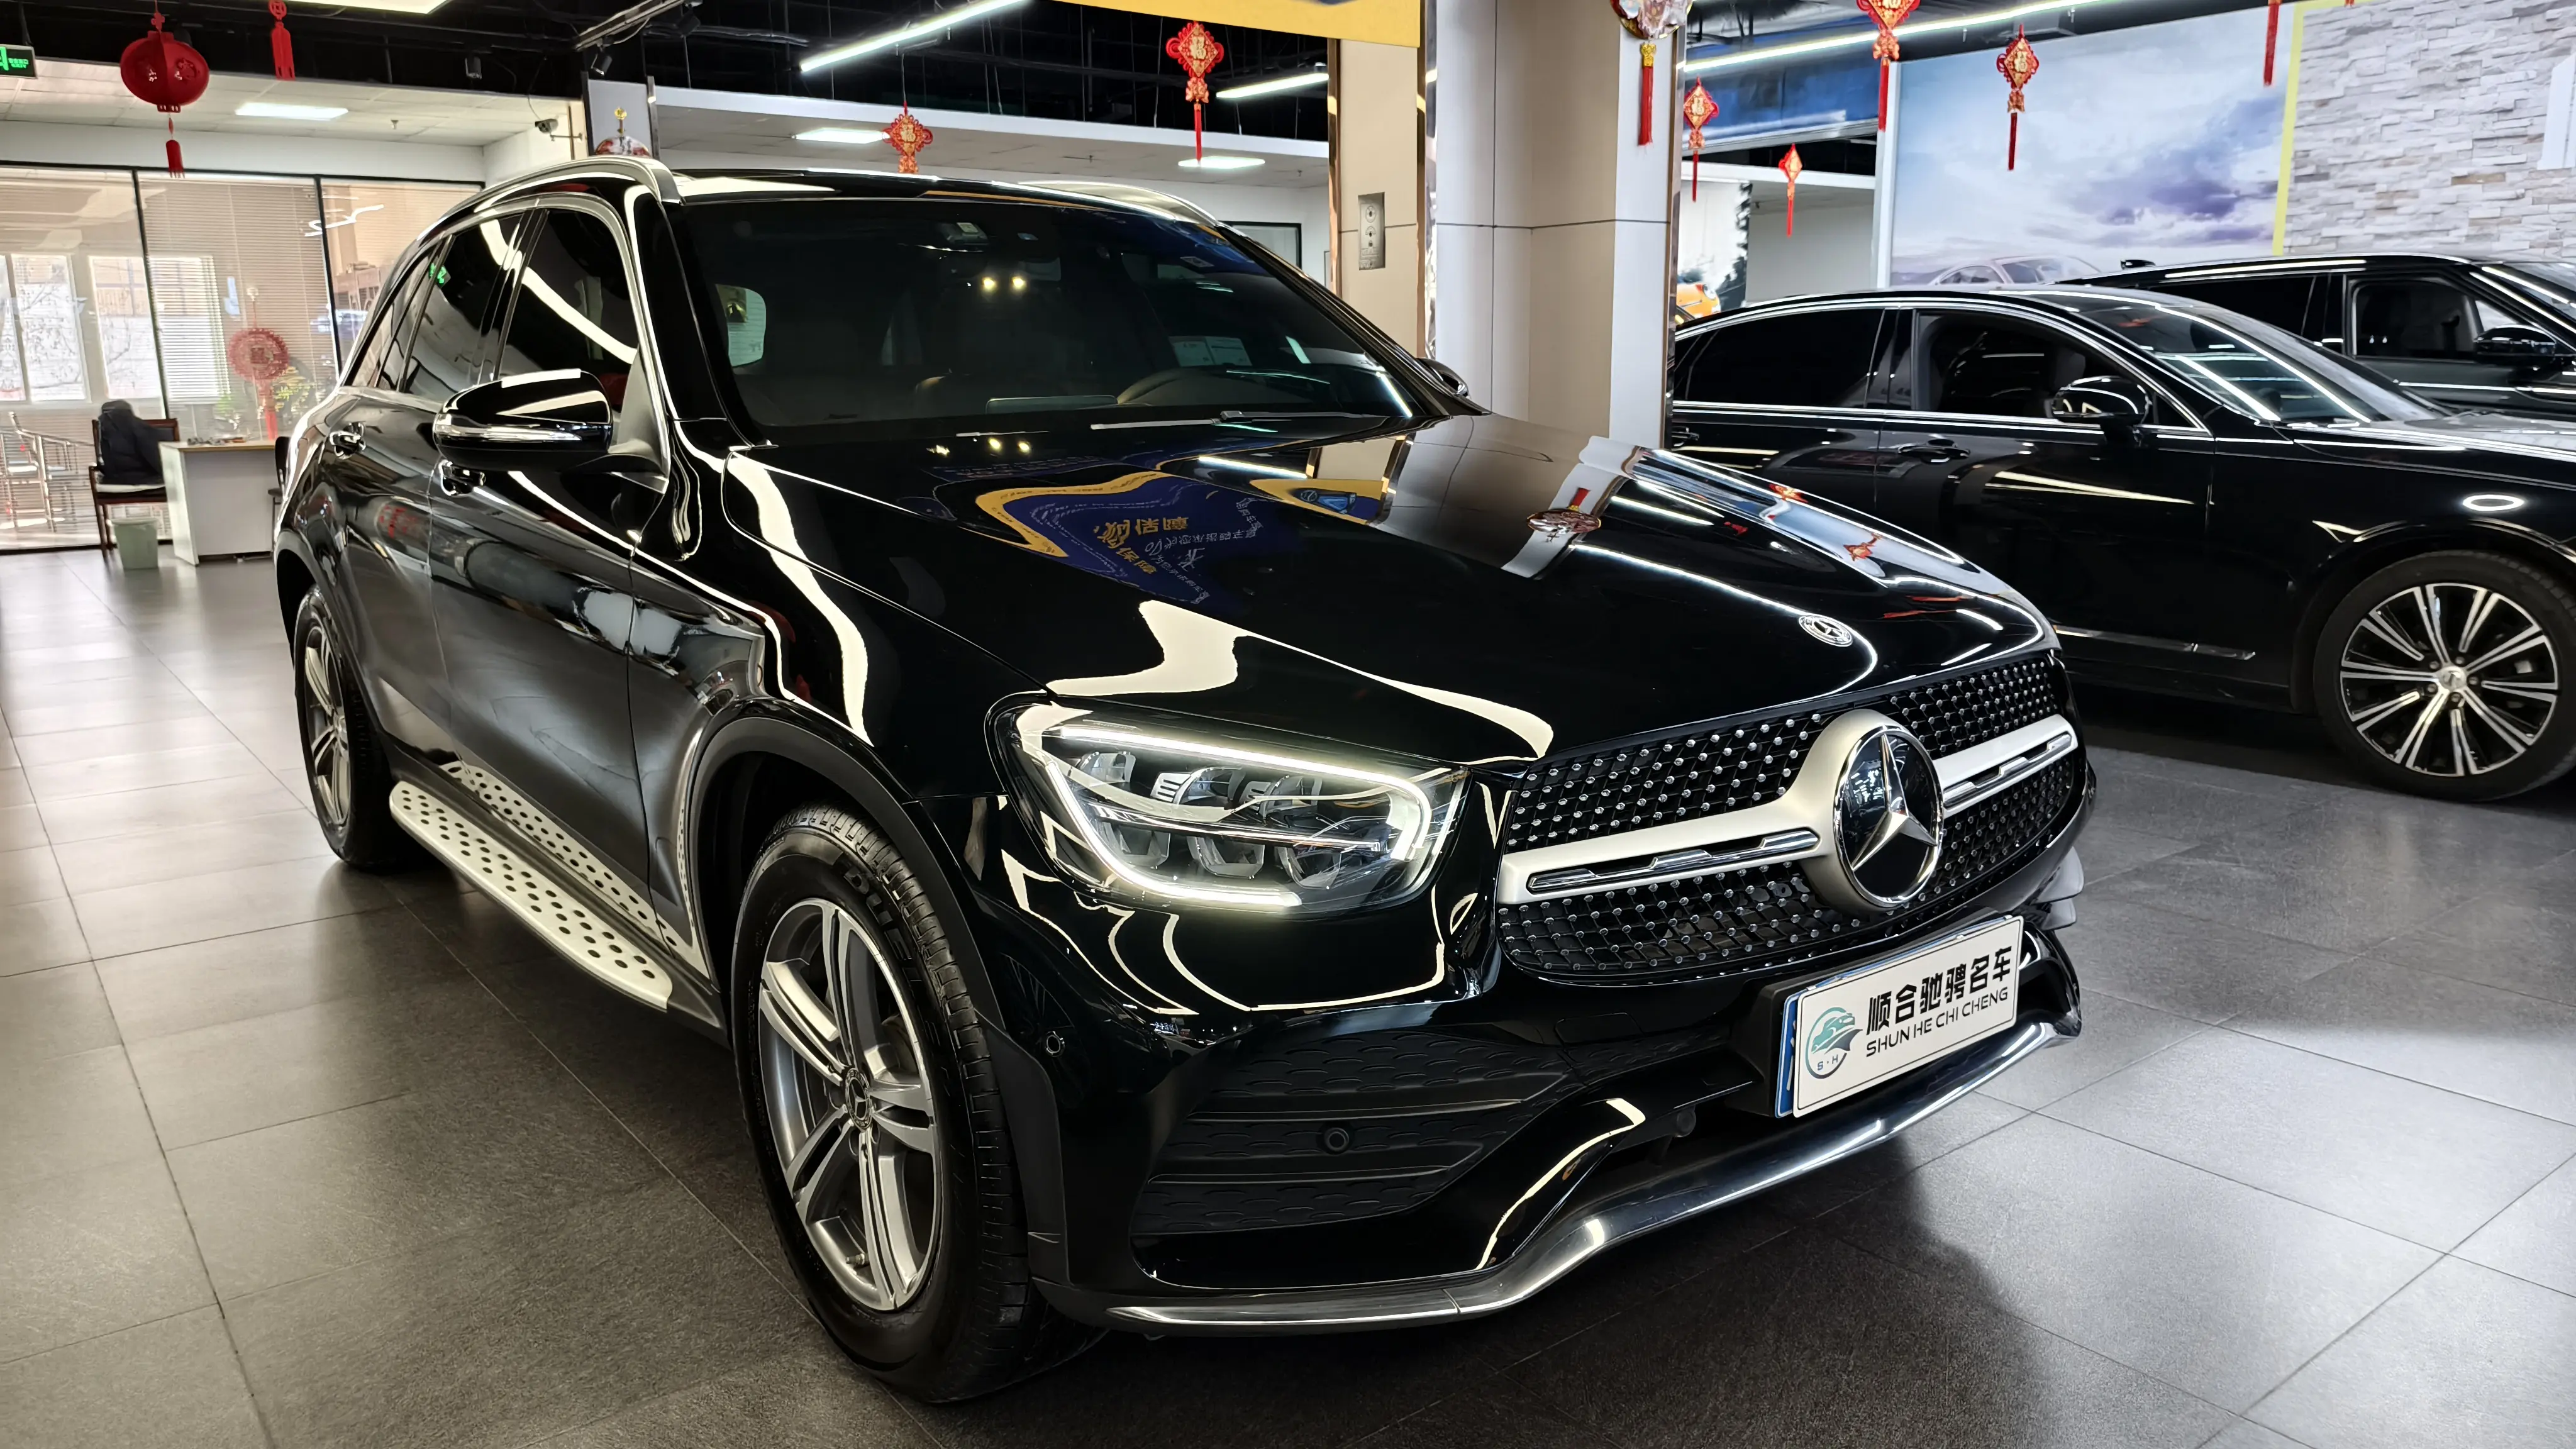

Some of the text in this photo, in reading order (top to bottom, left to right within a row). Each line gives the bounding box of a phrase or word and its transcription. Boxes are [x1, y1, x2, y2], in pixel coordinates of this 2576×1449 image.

[1866, 945, 2012, 1036] 顺合驰骋名车
[1866, 986, 2009, 1058] SHUN HE CHI CHENG
